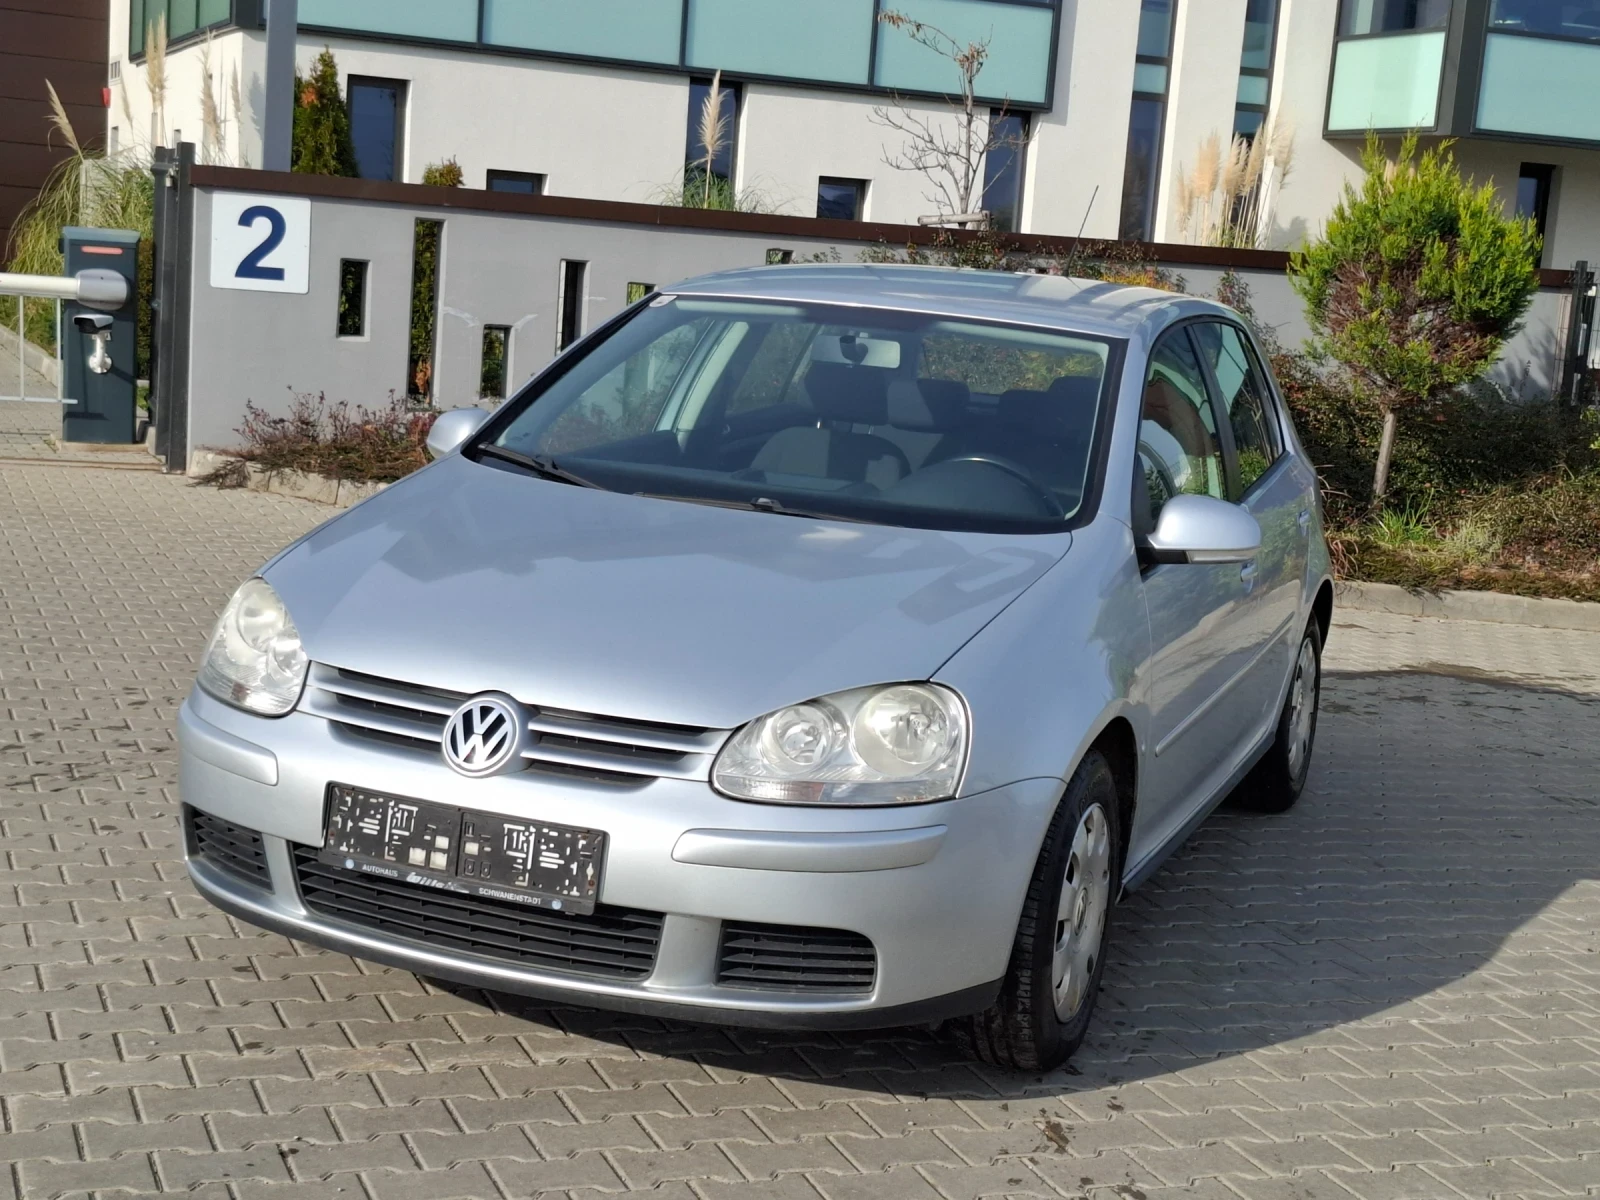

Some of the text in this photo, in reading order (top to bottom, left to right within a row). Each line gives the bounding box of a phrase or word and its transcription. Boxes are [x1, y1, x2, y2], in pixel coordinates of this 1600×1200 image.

[234, 205, 287, 281] 2
[447, 701, 513, 771] VW
[362, 863, 399, 878] AUTOHAUS
[478, 887, 542, 905] SCHWANENSTADT
